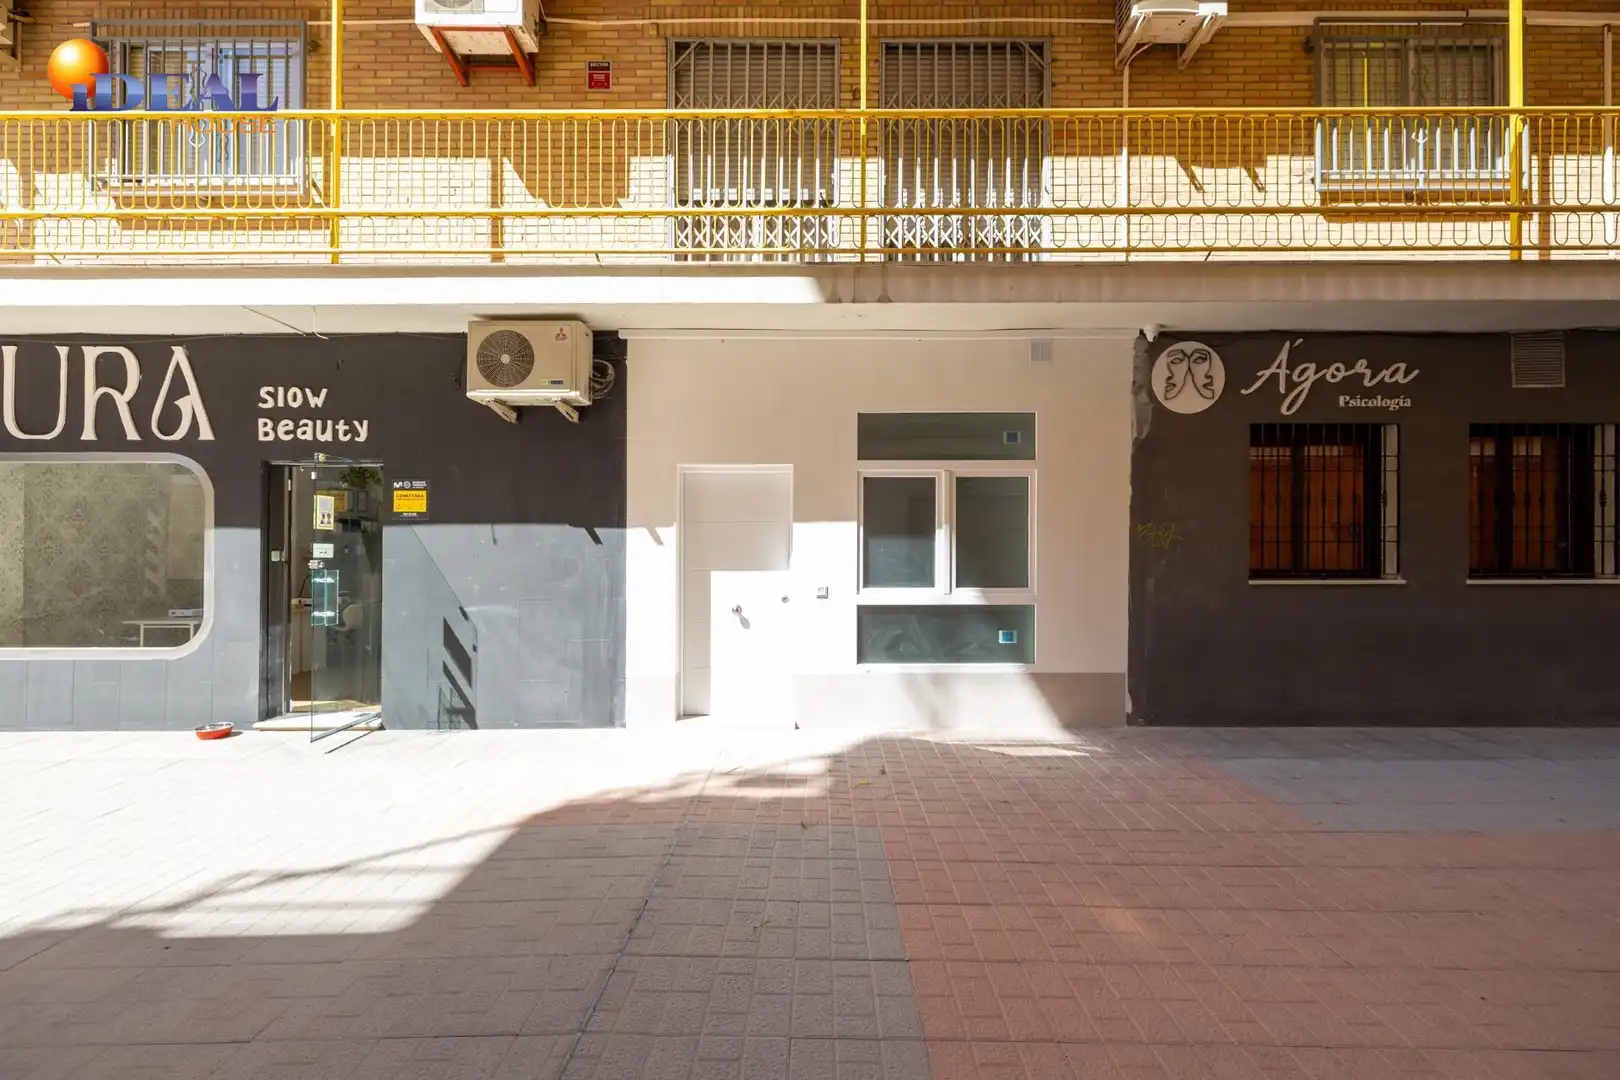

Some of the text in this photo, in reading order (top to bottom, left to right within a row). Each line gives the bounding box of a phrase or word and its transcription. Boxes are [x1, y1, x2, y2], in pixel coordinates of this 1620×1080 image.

[1, 345, 215, 441] URA
[1240, 338, 1420, 416] Ágora
[1338, 395, 1412, 411] Psicología
[257, 418, 369, 442] Beauty
